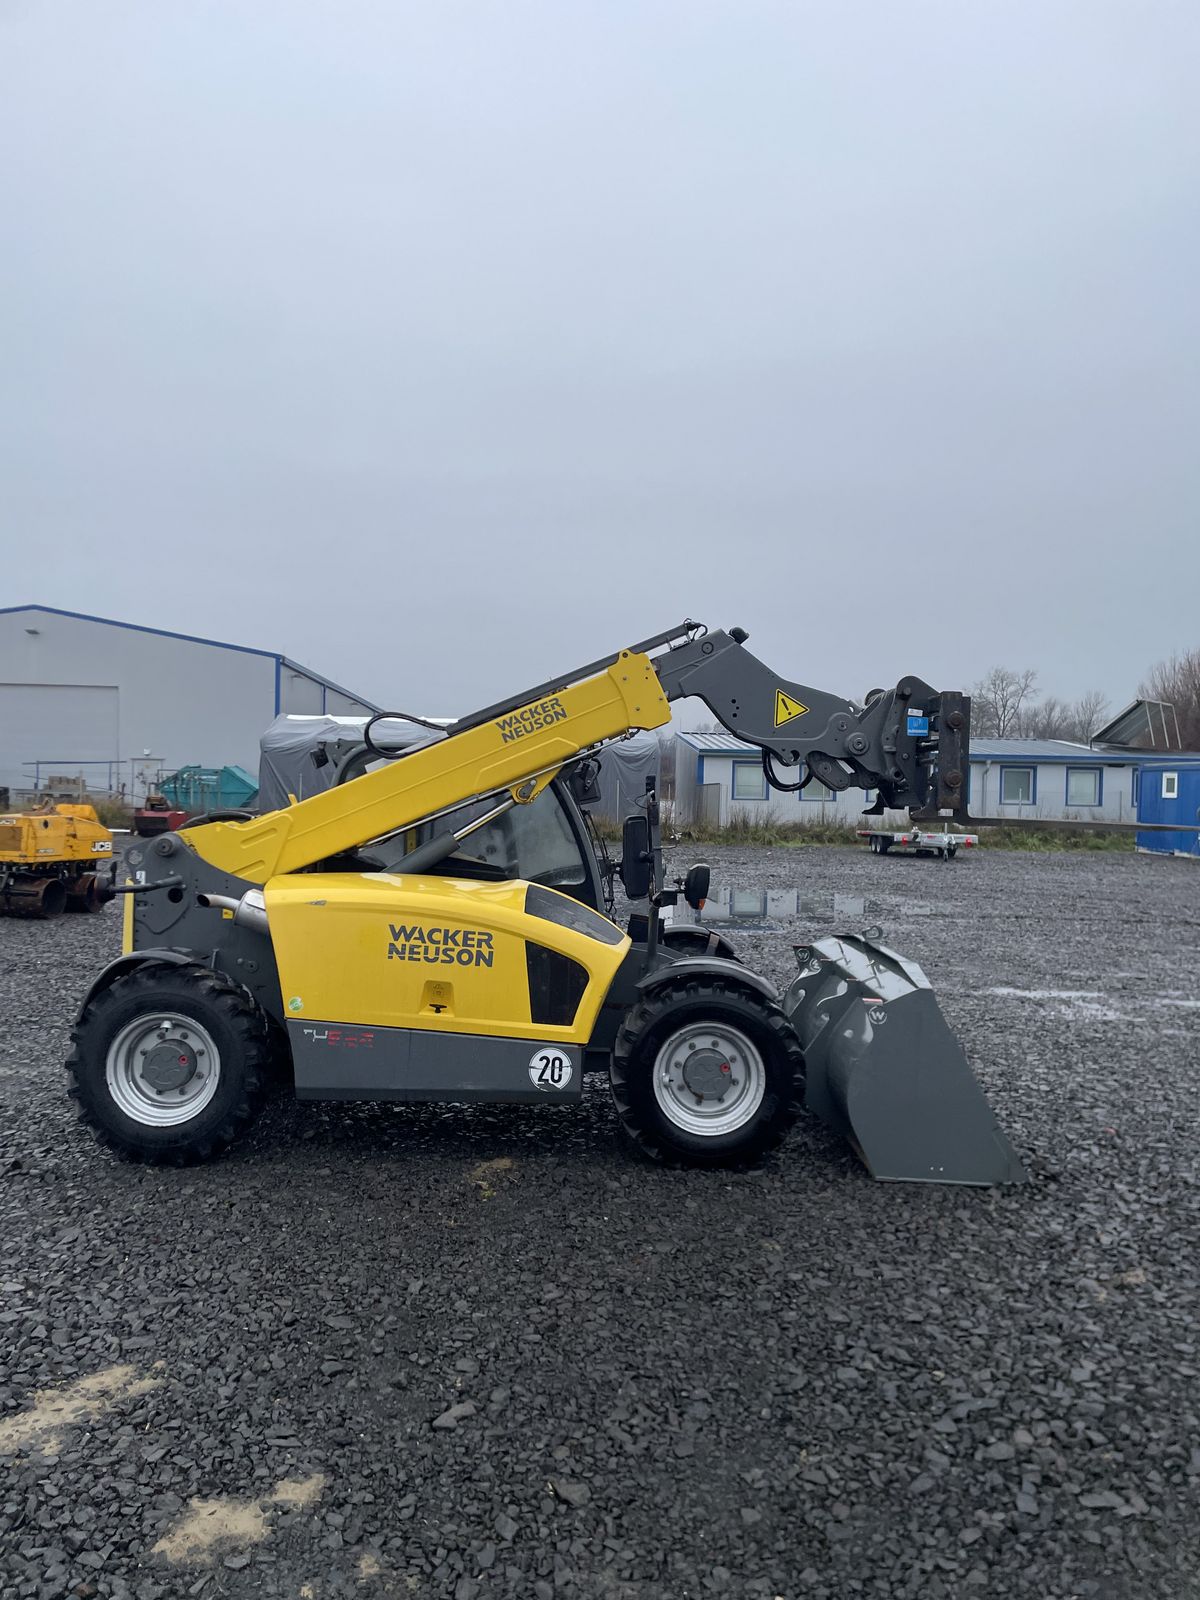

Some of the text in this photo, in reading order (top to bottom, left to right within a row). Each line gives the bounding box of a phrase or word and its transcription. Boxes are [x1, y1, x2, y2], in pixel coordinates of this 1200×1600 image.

[495, 697, 563, 731] WACKER
[501, 707, 568, 744] NEUSON
[91, 841, 112, 852] JCB
[388, 923, 494, 950] WACKER
[387, 942, 494, 968] NEUSON
[538, 1055, 563, 1084] 20
